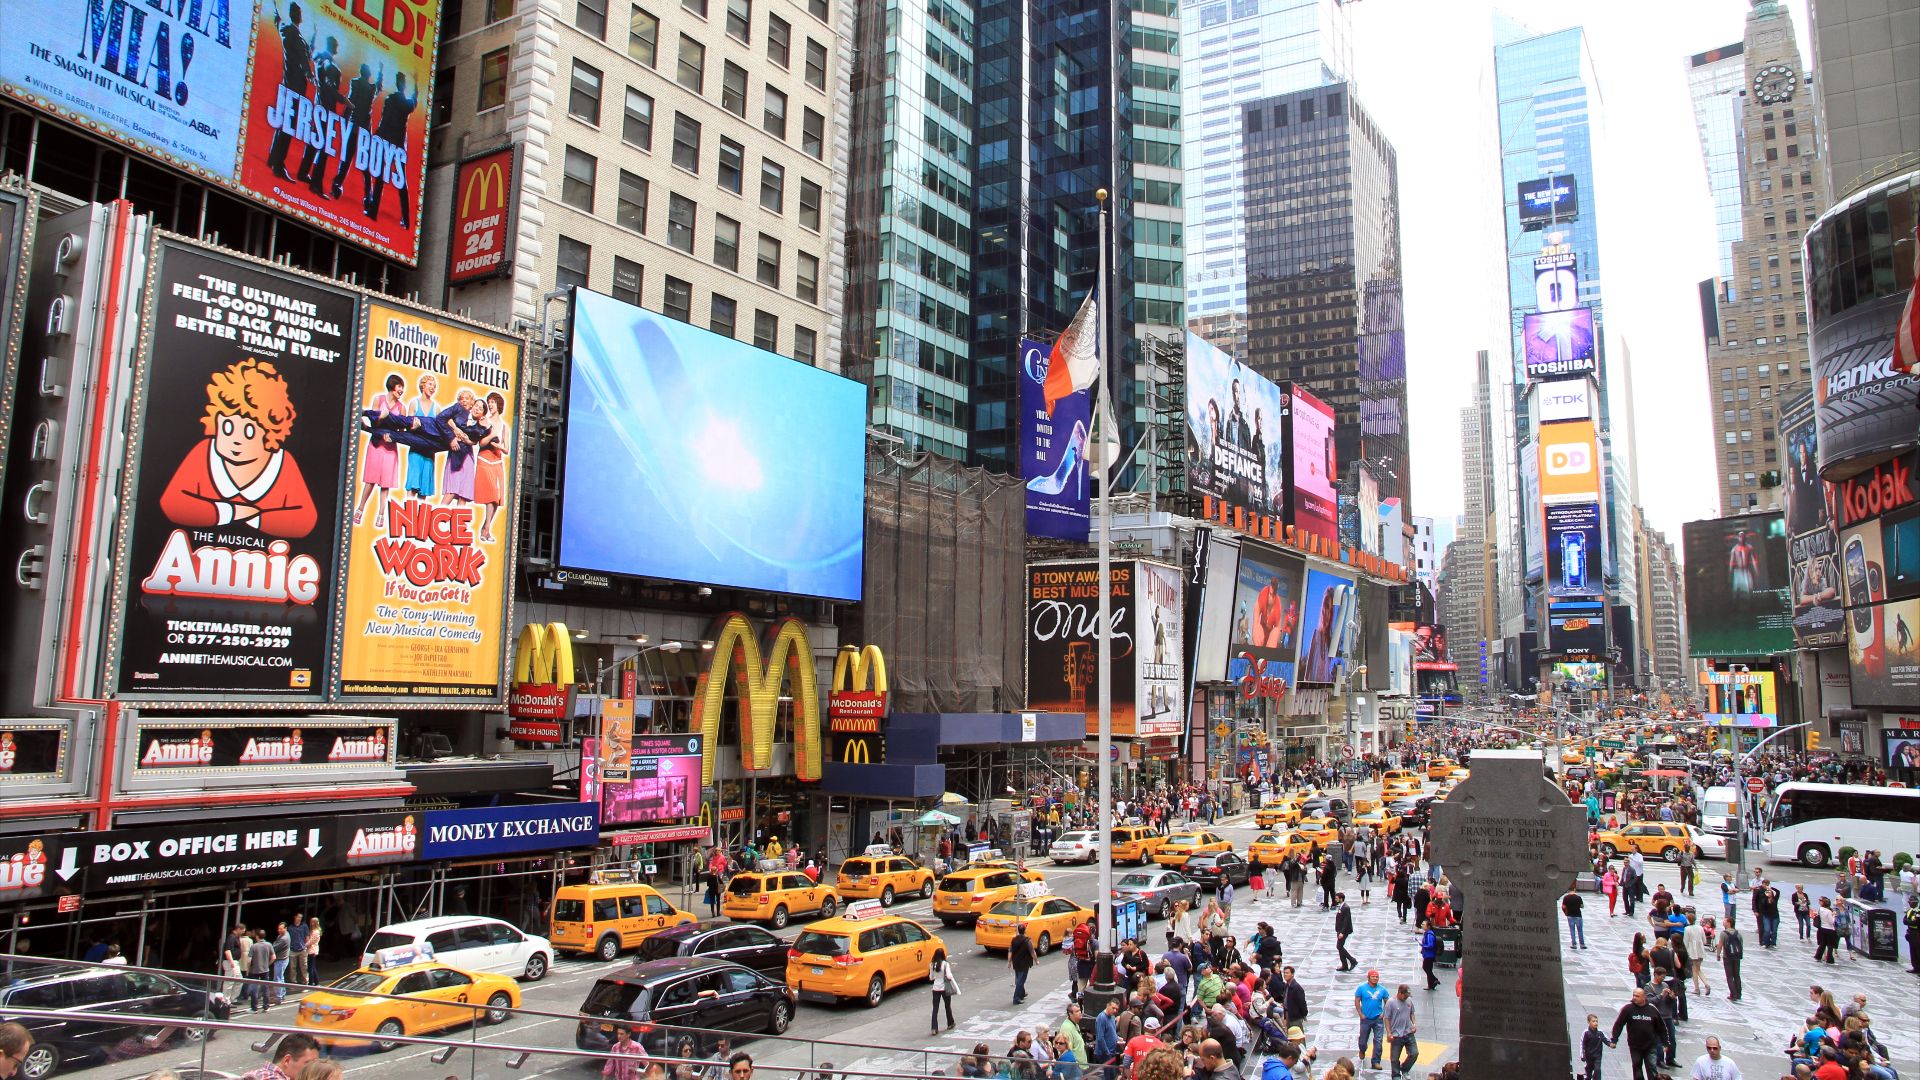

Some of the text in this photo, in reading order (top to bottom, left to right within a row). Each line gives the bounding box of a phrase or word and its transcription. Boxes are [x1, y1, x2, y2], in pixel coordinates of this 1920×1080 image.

[338, 13, 354, 28] New
[355, 21, 369, 38] York
[371, 33, 390, 50] Times
[28, 42, 157, 113] THE SMASH HIT MUSICAL
[32, 78, 63, 97] WINTER
[65, 91, 96, 112] GARDEN
[132, 122, 171, 148] Broadway
[172, 138, 178, 148] &
[267, 83, 408, 190] JERSEY BOYS
[1524, 191, 1536, 200] THE
[1537, 189, 1551, 198] NEW
[279, 190, 299, 207] August
[299, 196, 318, 213] Wilson
[339, 213, 350, 224] 245
[349, 218, 363, 231] West
[375, 229, 390, 244] Street
[463, 214, 500, 234] OPEN
[465, 231, 494, 256] 24
[455, 251, 501, 273] HOURS
[1534, 254, 1576, 265] TOSHIBA
[172, 282, 341, 337] FEEL-GOOD MUSICAL
[241, 285, 317, 317] ULTIMATE
[175, 314, 237, 340] BETTER
[241, 329, 286, 351] THAN
[205, 306, 311, 343] IS BACK AND
[253, 347, 279, 358] MAGAZINE
[388, 319, 501, 366] Matthew Jessie
[374, 337, 509, 390] BRODERICK MUELLER
[1528, 358, 1594, 376] TOSHIBA
[1552, 394, 1584, 405] TDK
[1842, 380, 1881, 402] driving
[16, 232, 83, 590] PALACE
[1215, 445, 1262, 484] DEFIANCE
[1841, 456, 1914, 525] Kodak
[388, 499, 474, 546] NICE
[193, 531, 266, 548] THE MUSICAL
[1792, 531, 1831, 563] GATSBY
[141, 528, 321, 605] Annie
[374, 539, 487, 587] WORK
[1033, 572, 1041, 584] 8
[1042, 571, 1075, 584] TONY
[385, 581, 471, 604] If You Can Get It
[1033, 585, 1067, 599] BEST
[376, 605, 476, 627] The Tony-Winning
[167, 620, 292, 637] TICKETMASTER.COM
[364, 622, 482, 643] New Musical Comedy
[167, 632, 290, 648] OR 877-250-2929
[159, 652, 293, 667] ANNIETHEMUSICAL.COM
[1143, 663, 1179, 680] NEWSIES
[1238, 652, 1287, 715] Disney
[510, 693, 564, 706] McDonald's
[518, 706, 554, 715] Restaurant
[831, 699, 882, 708] McDonald's
[528, 728, 536, 736] 24
[537, 728, 558, 737] HOURS
[654, 739, 671, 747] SQUARE
[141, 738, 213, 766] Annie
[239, 737, 303, 764] Annie
[328, 735, 385, 761] Annie
[429, 815, 593, 844] MONEY EXCHANGE
[1460, 826, 1505, 837] FRANCIS
[1518, 828, 1558, 839] DUFFY
[1466, 817, 1549, 827] LIEUTENANT COLONEL
[93, 829, 298, 864] BOX OFFICE HERE
[347, 824, 416, 857] Annie
[1472, 850, 1545, 861] CATHOLIC PRIEST
[106, 860, 284, 885] ANNIETHEMUSICAL.COM OR 877-250-2929
[1489, 869, 1528, 878] CHAPLAIN
[1483, 908, 1547, 919] LIFE SERVICE
[1472, 922, 1550, 934] GOD AND COUNTRY
